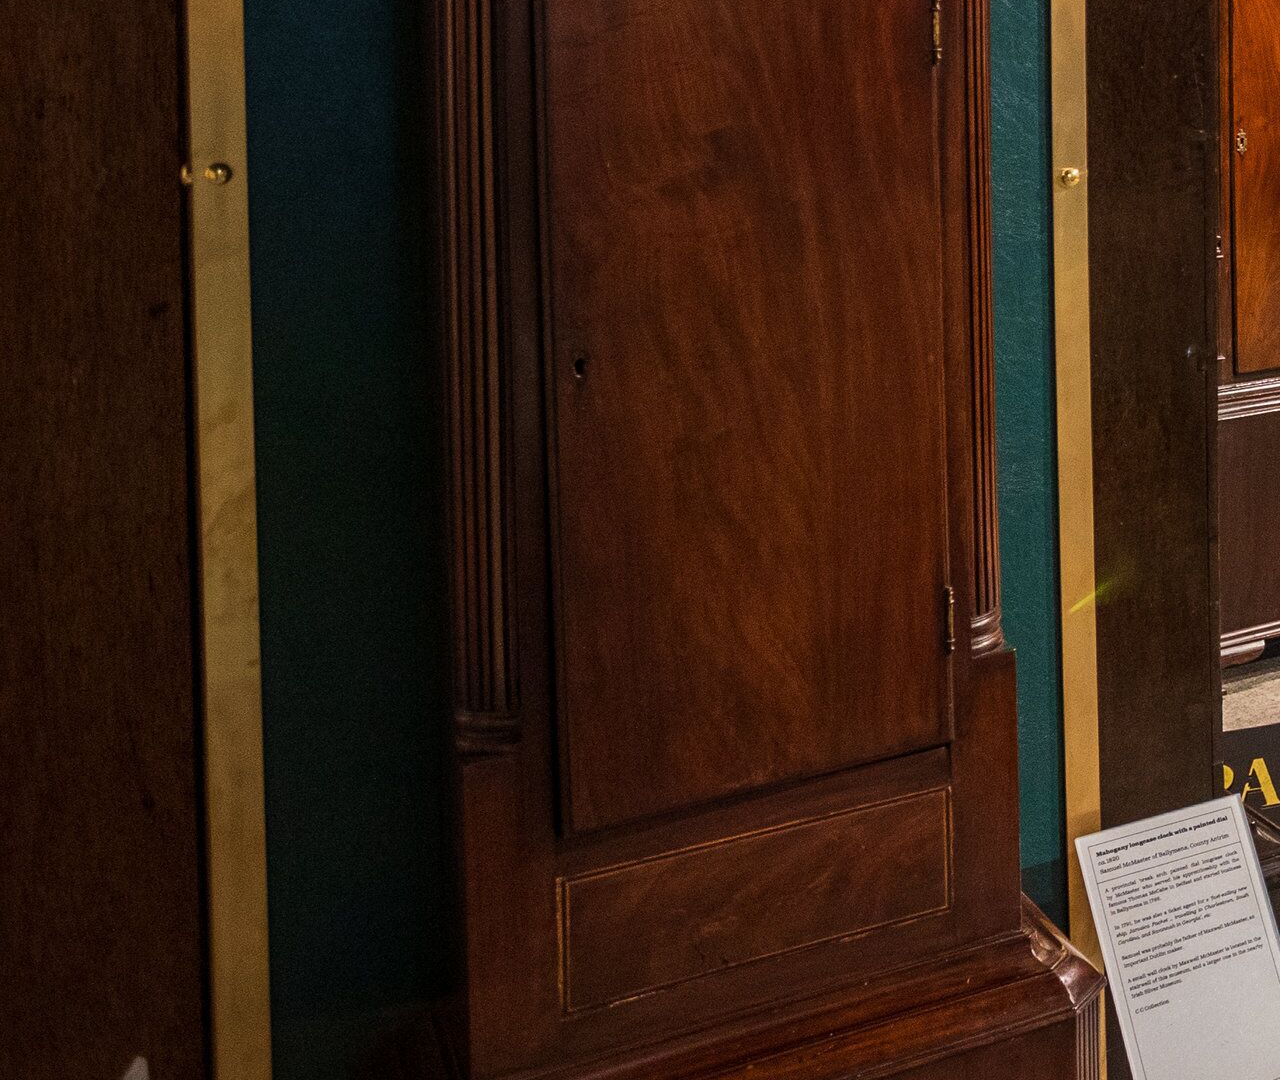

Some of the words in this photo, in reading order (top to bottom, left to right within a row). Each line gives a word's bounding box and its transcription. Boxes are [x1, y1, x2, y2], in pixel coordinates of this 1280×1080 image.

[1095, 844, 1128, 857] Mahogany
[1128, 836, 1156, 847] longcase
[1157, 831, 1173, 839] clock
[1192, 818, 1215, 830] painted
